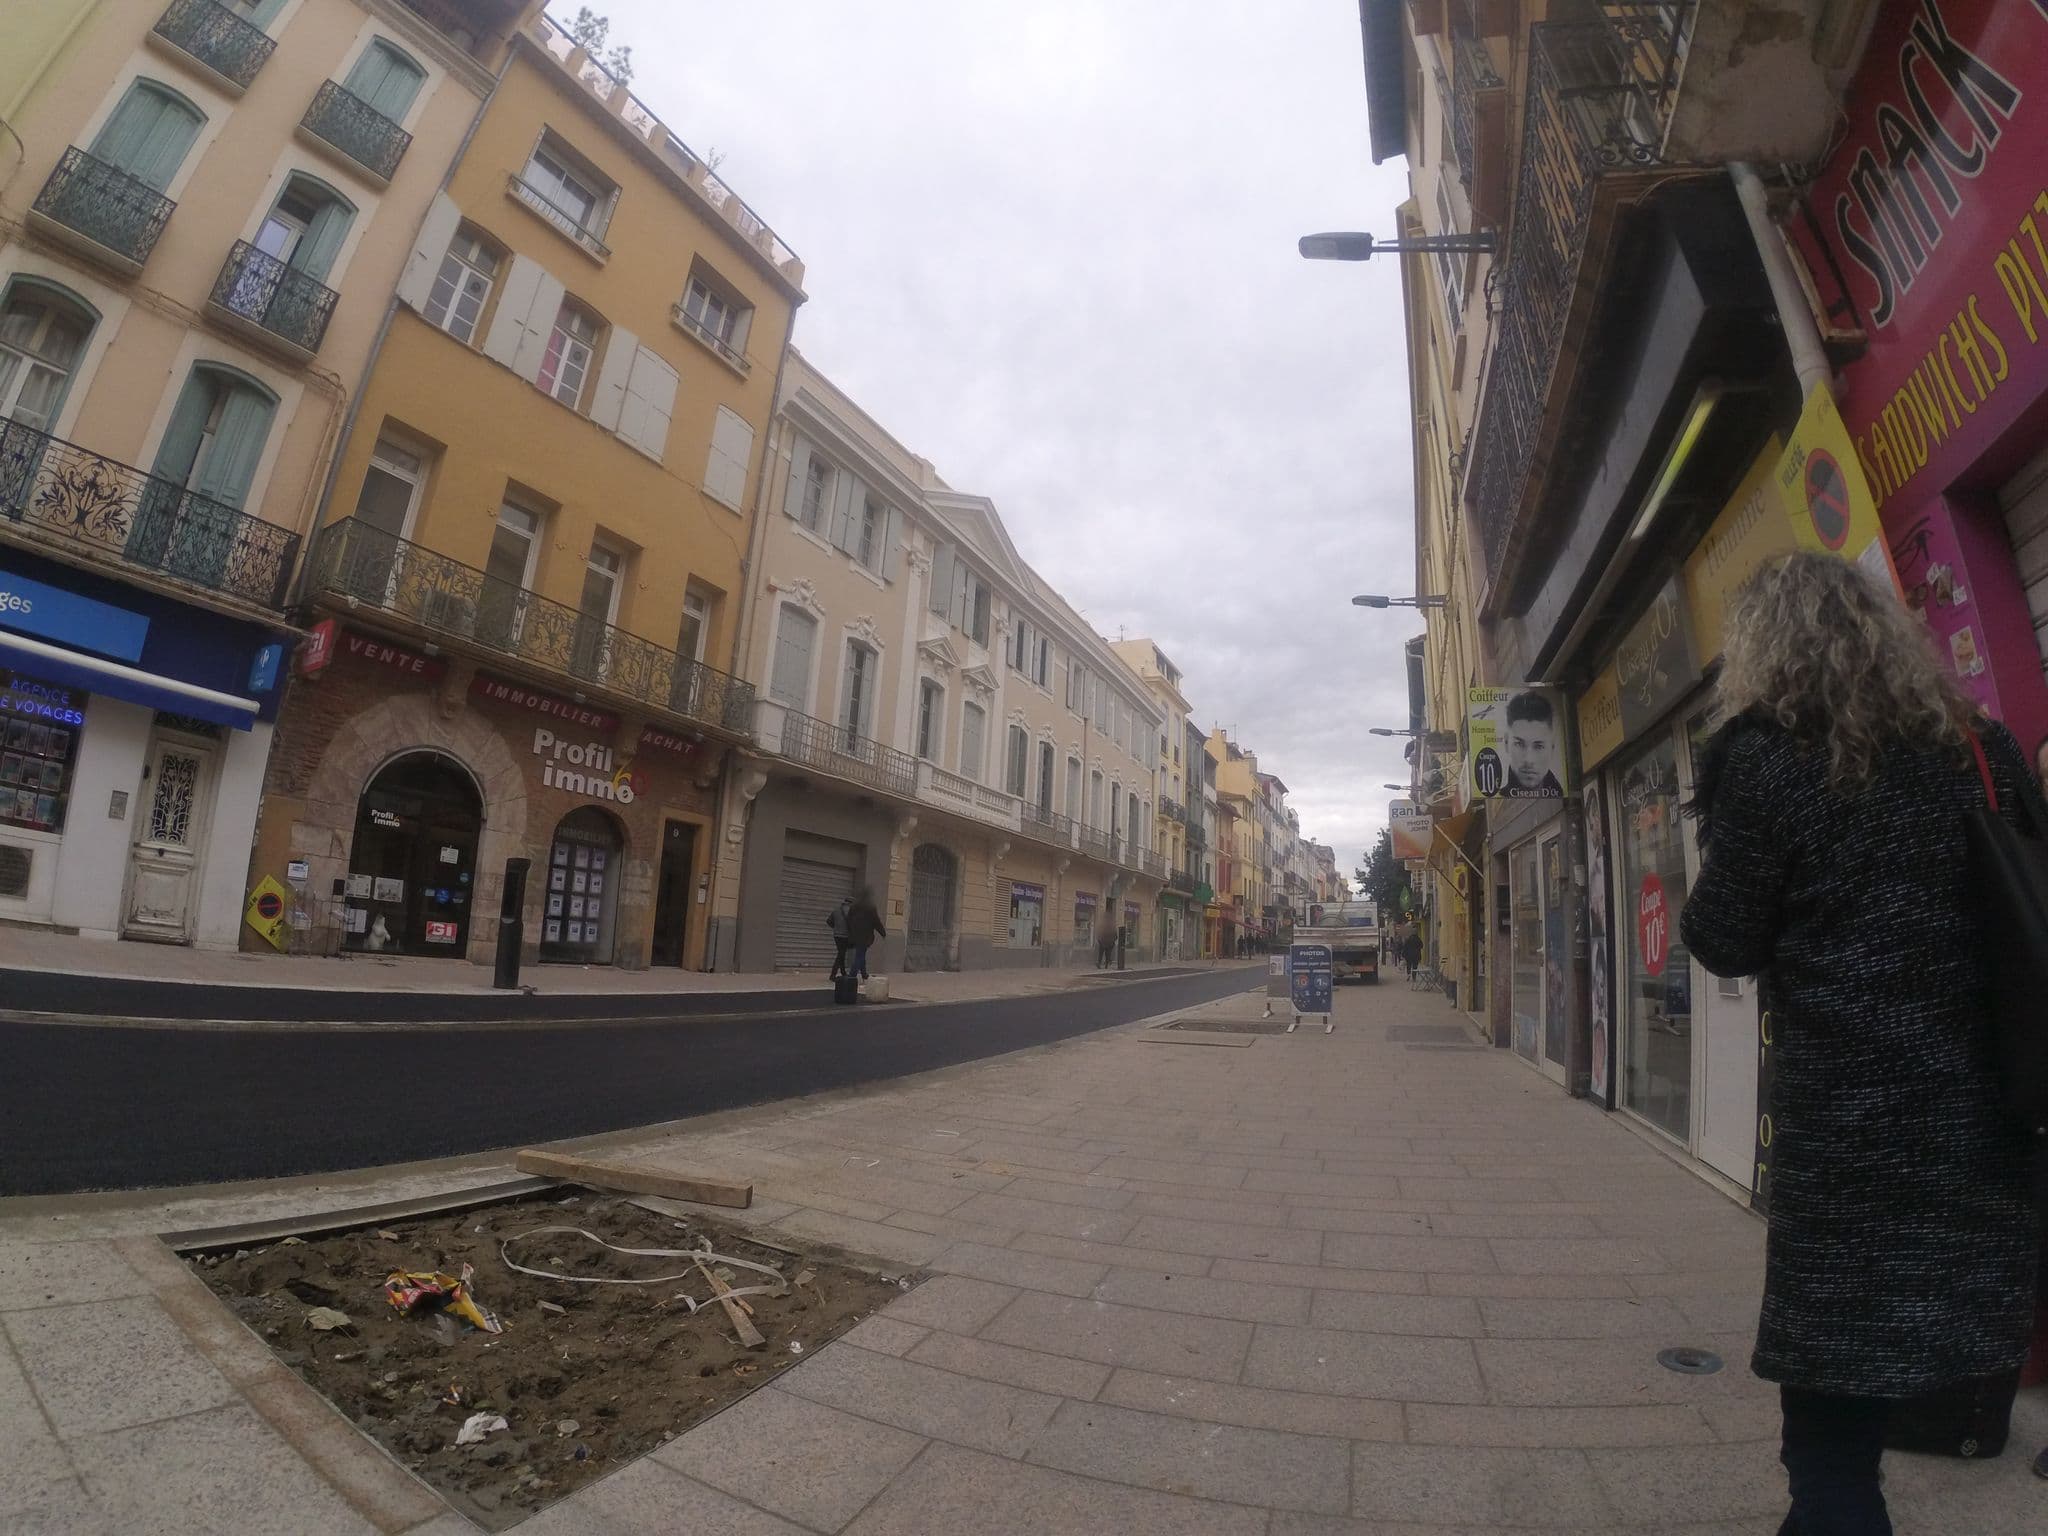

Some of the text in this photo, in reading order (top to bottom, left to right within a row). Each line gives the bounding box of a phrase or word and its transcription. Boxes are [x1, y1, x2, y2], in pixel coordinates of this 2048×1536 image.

[1836, 0, 2023, 329] SNACK
[1855, 188, 2048, 510] SANDWICHS PIZ
[350, 637, 425, 673] VENTE
[10, 678, 70, 705] AGENCE
[485, 681, 602, 728] IMMOBILIER
[1469, 689, 1508, 702] Coiffeur
[15, 699, 83, 725] VOYAGES
[532, 728, 614, 773] Profil
[642, 733, 695, 754] ACHAT
[543, 760, 635, 804] immo
[1509, 786, 1561, 798] Ciseau D'Or
[371, 809, 395, 821] Profil
[1391, 807, 1414, 819] gan
[1407, 819, 1430, 828] PHOTO
[1641, 889, 1661, 917] Coupe
[431, 922, 452, 937] GI
[1644, 913, 1665, 965] 10€
